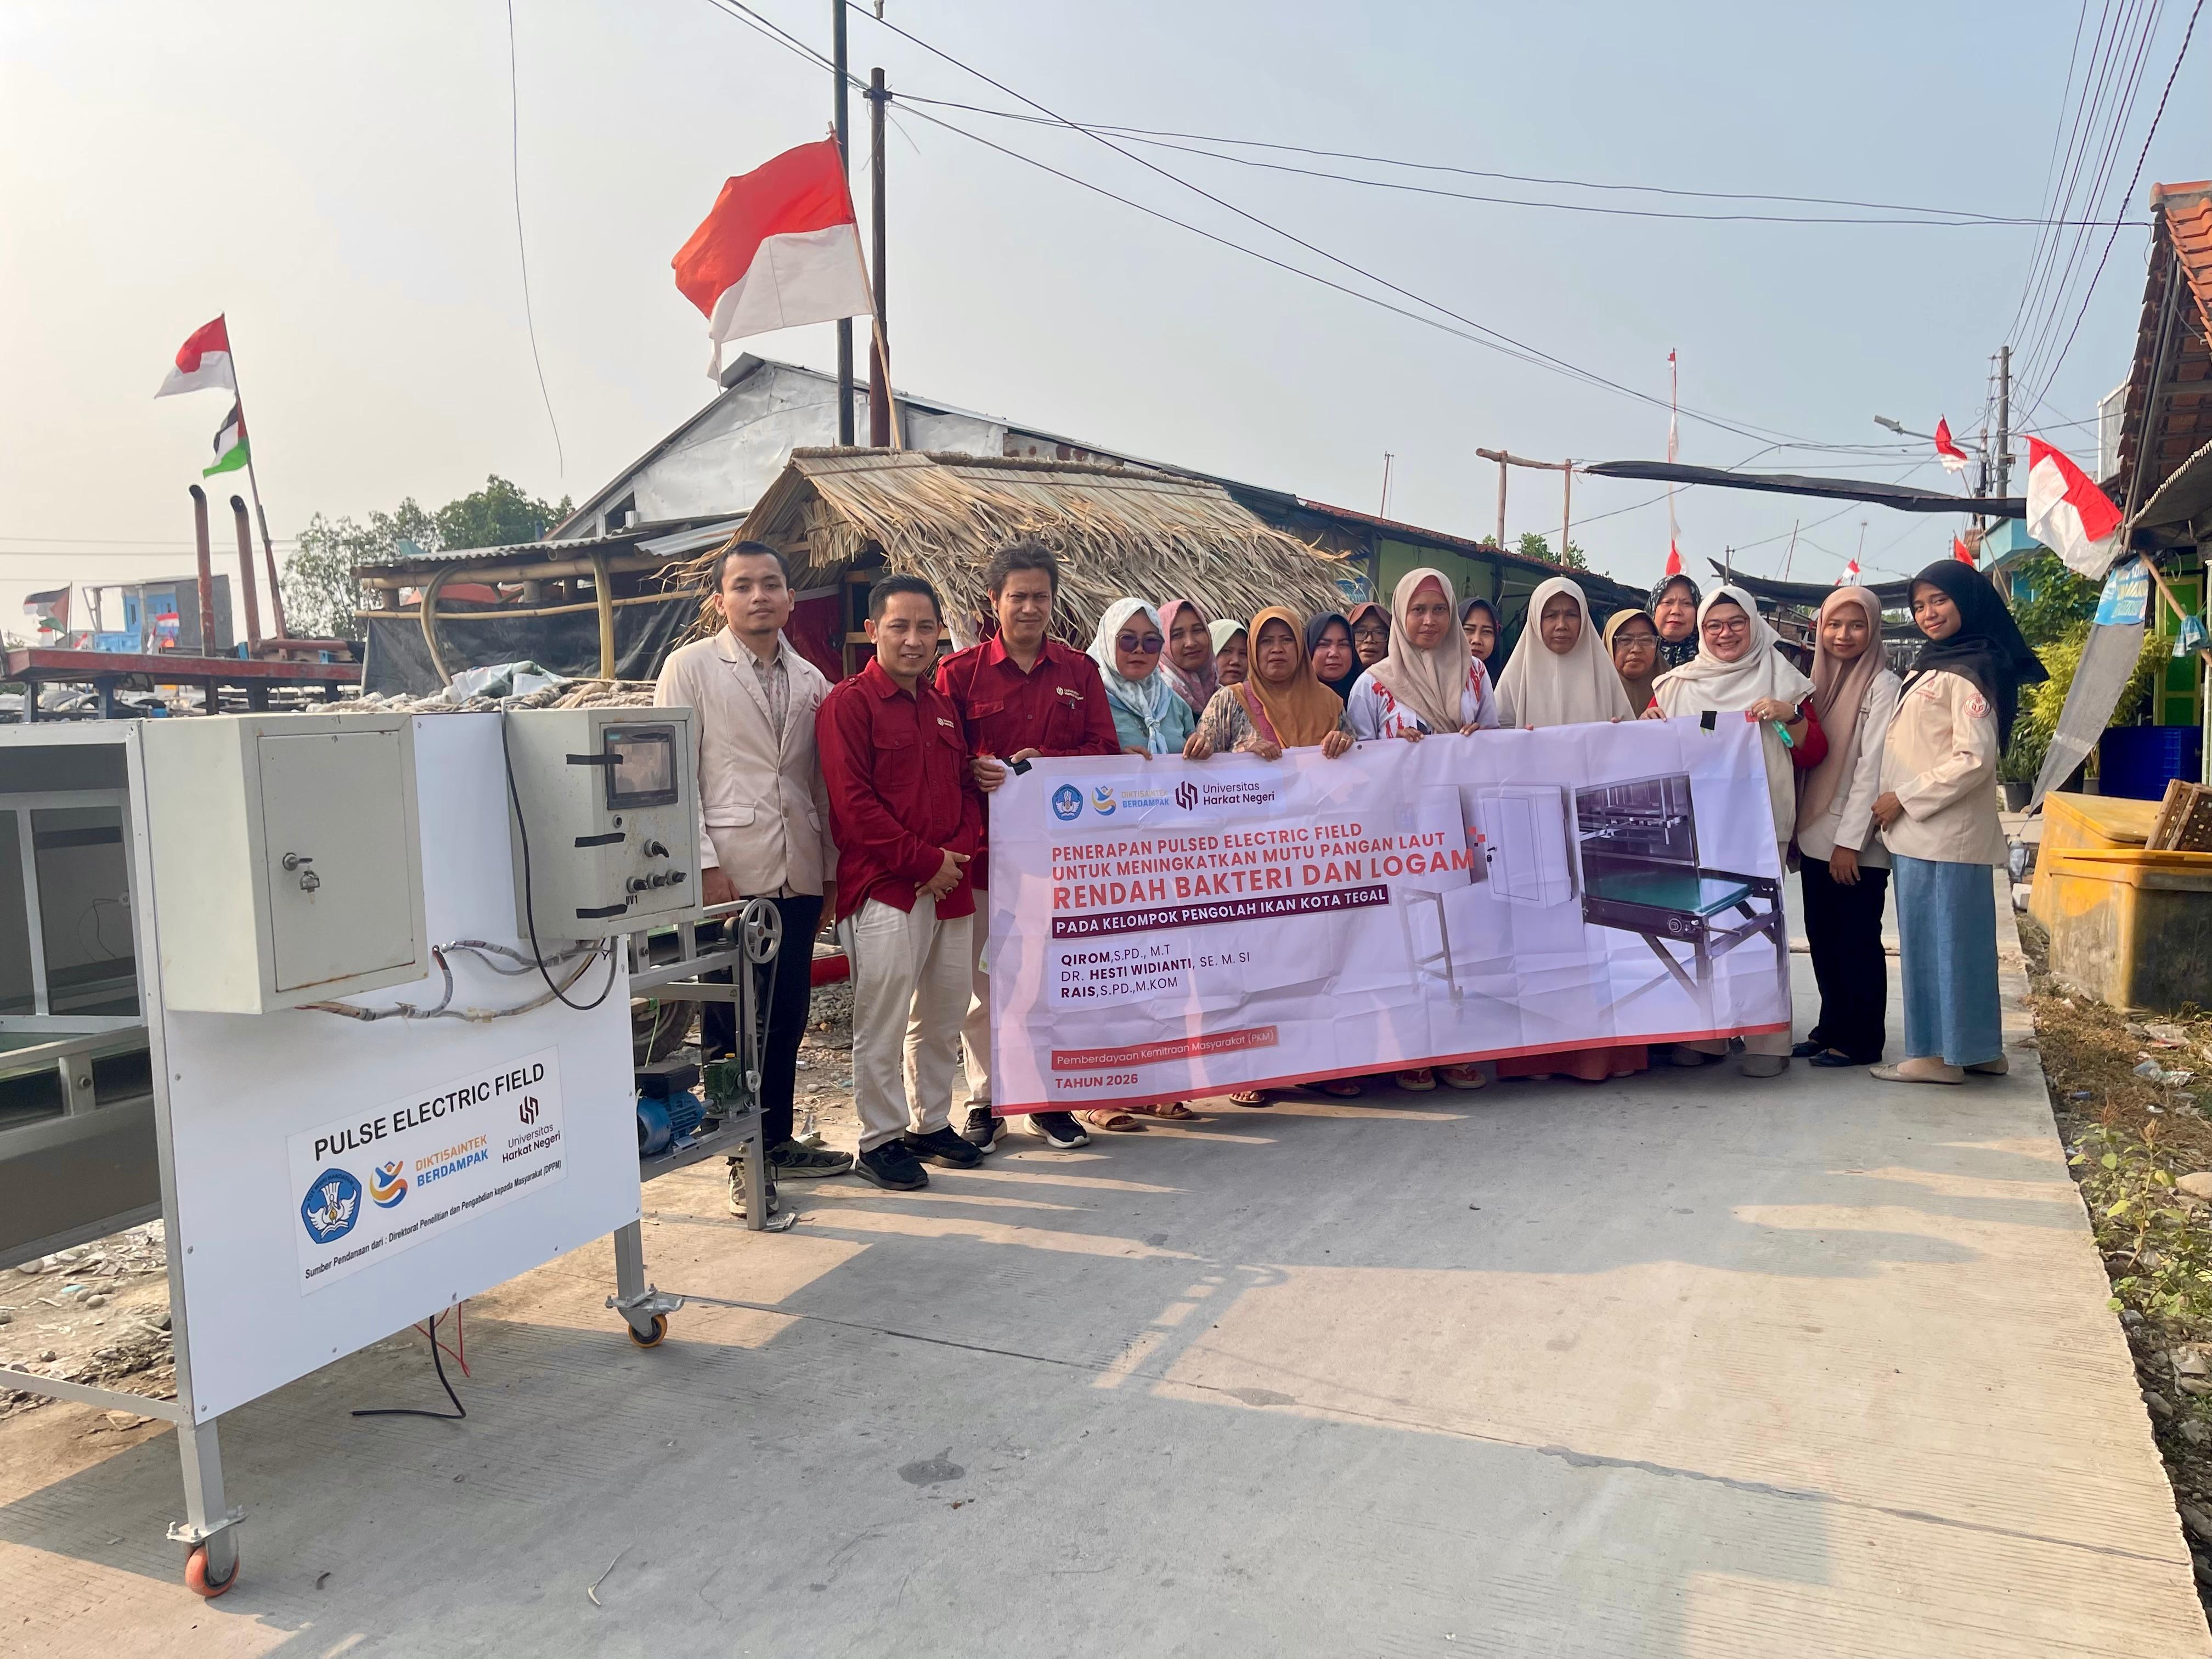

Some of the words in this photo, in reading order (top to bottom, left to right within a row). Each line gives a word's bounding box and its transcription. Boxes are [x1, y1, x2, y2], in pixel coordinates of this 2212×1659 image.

[1121, 790, 1168, 798] DIKTISAINTEK
[1122, 799, 1170, 808] BERDAMPAK
[1203, 782, 1259, 794] Universitas
[1203, 794, 1239, 805] Harkat
[1243, 791, 1274, 804] Negeri
[1052, 840, 1152, 862] PENERAPAN
[1158, 836, 1219, 854] PULSED
[1224, 828, 1309, 849] ELECTRIC
[1314, 823, 1362, 840] FIELD
[1053, 862, 1111, 881] UNTUK
[1116, 850, 1256, 876] MENINGKATKAN
[1263, 845, 1314, 863] MUTU
[1320, 837, 1393, 857] PANGAN
[1399, 832, 1445, 849] LAUT
[1053, 878, 1166, 909] RENDAH
[1175, 867, 1292, 899] BAKTERI
[1302, 859, 1362, 886] DAN
[1371, 848, 1474, 878] LOGAM
[1057, 921, 1099, 933] PADA
[1103, 911, 1179, 930] KELOMPOK
[1182, 902, 1256, 921] PENGOLAH
[1261, 899, 1296, 913] IKAN
[1301, 894, 1341, 909] KOTA
[1344, 888, 1385, 905] TEGAL
[1062, 971, 1084, 981] DR.
[1090, 966, 1127, 980] HESTI
[1131, 958, 1195, 975] WIDIANTI,
[1200, 956, 1218, 967] SE.
[1222, 954, 1235, 965] M.
[1239, 952, 1250, 962] SI
[1150, 944, 1170, 956] M.T
[1057, 1052, 1138, 1065] Pemberdayaan
[1141, 1044, 1189, 1058] Kemitraan
[1191, 1035, 1245, 1052] Masyarakat
[1248, 1029, 1274, 1045] (PKM)
[1055, 1076, 1103, 1089] TAHUN
[1107, 1074, 1138, 1086] 2026
[315, 1117, 387, 1161] PULSE
[393, 1082, 490, 1132] ELECTRIC
[495, 1063, 544, 1096] FIELD
[415, 1134, 488, 1172] DIKTISAINTEK
[502, 1144, 532, 1164] Harkat
[533, 1130, 561, 1151] Negeri
[508, 1124, 554, 1148] Universitas
[417, 1148, 489, 1188] BERDAMPAK
[305, 1260, 332, 1279] Sumber
[334, 1245, 369, 1267] Pendanaan
[371, 1237, 383, 1250] dari
[388, 1222, 419, 1243] Direktorat
[420, 1210, 448, 1230] Penelitian
[449, 1205, 460, 1216] dan
[461, 1191, 493, 1211] Pengabdian
[494, 1181, 512, 1196] kepada
[514, 1169, 542, 1187] Masyarakat
[543, 1160, 561, 1176] (DPPM)
